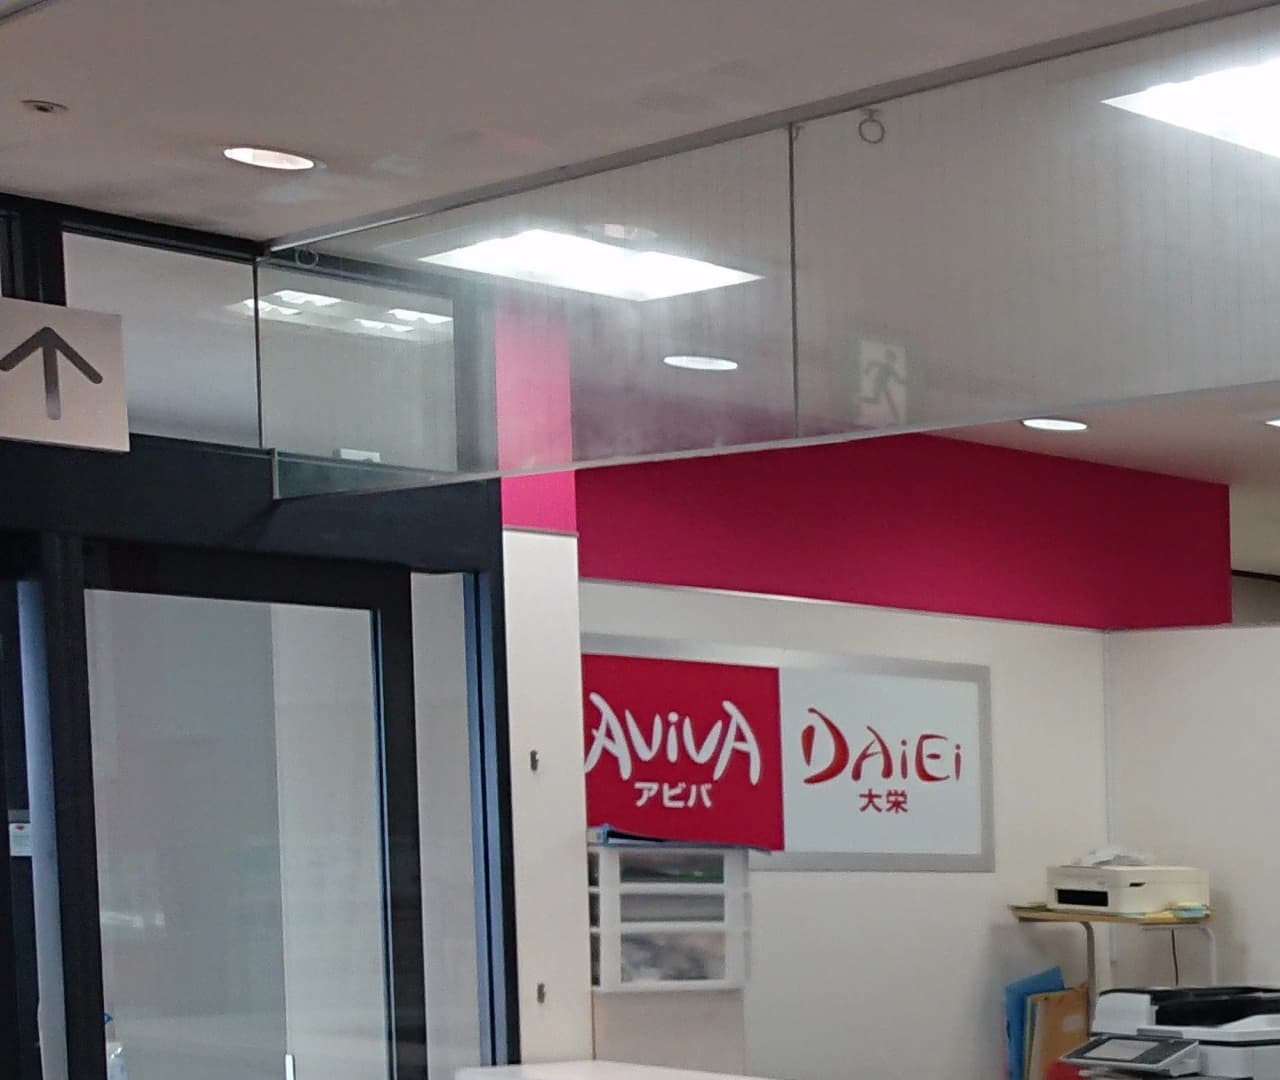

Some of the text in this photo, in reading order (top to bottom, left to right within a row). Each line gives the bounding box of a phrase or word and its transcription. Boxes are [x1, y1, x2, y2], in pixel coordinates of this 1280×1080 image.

[634, 782, 908, 813] アビバ 大栄
